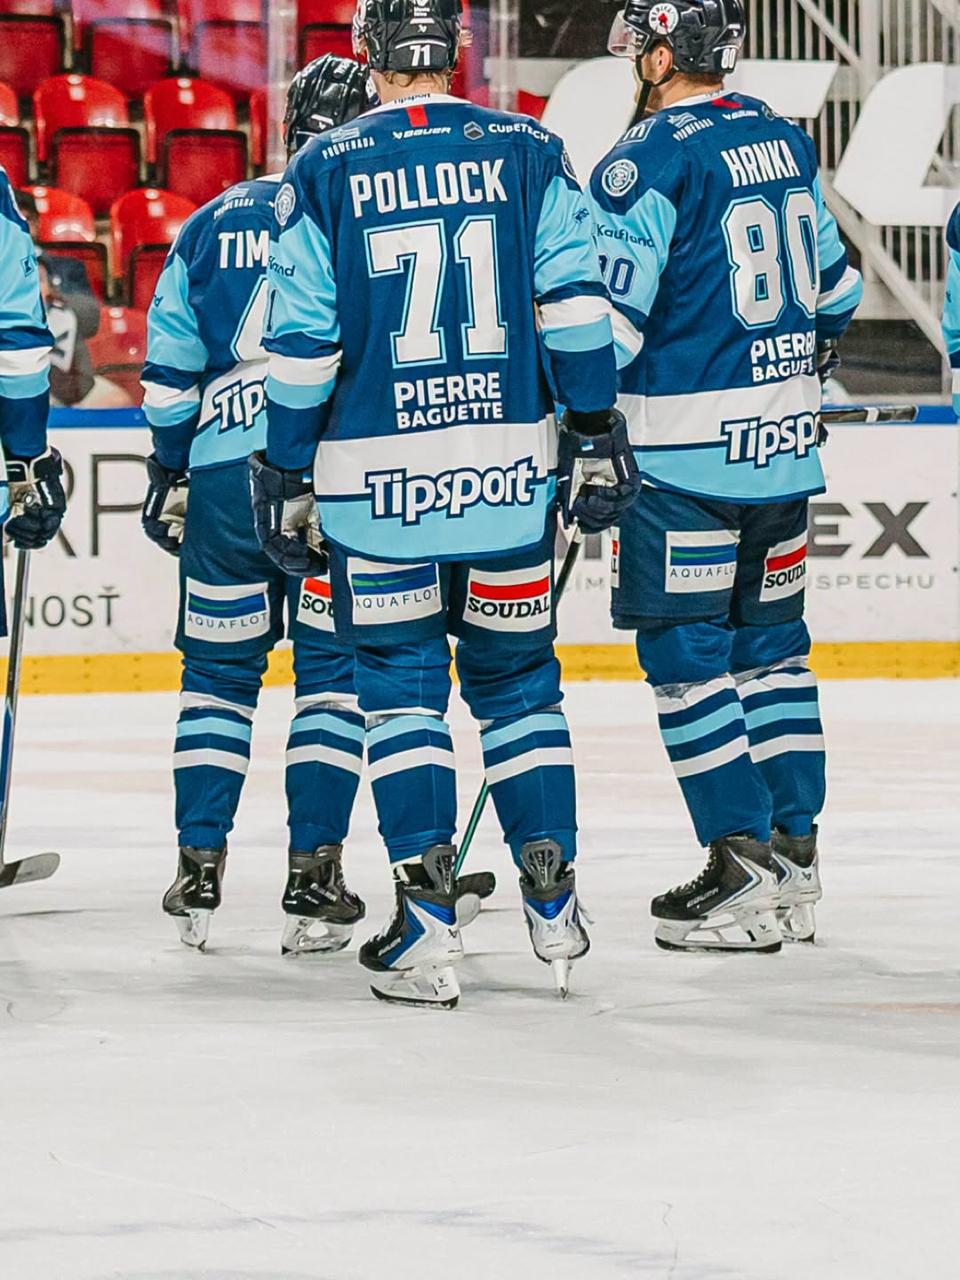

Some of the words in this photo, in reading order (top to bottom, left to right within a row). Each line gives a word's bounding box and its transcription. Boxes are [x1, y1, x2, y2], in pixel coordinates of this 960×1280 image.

[410, 44, 431, 67] 71
[721, 47, 737, 69] 80
[403, 126, 452, 138] BAUER
[488, 123, 550, 144] CUBETECH
[720, 140, 801, 188] HRNKA
[349, 158, 508, 218] POLLOCK
[596, 223, 656, 248] Kaufland
[218, 230, 270, 269] TIM
[720, 187, 819, 330] 80
[363, 214, 509, 369] 71
[394, 371, 502, 410] PIERRE
[396, 400, 505, 430] BAGUETTE
[722, 414, 819, 468] Tipsp
[366, 457, 538, 525] Tipsport
[808, 573, 936, 590] SPECHU
[300, 593, 333, 618] SOU
[355, 586, 440, 610] AQUAFLOT
[468, 596, 551, 620] SOUDAL
[187, 612, 269, 629] AQUAFLOT
